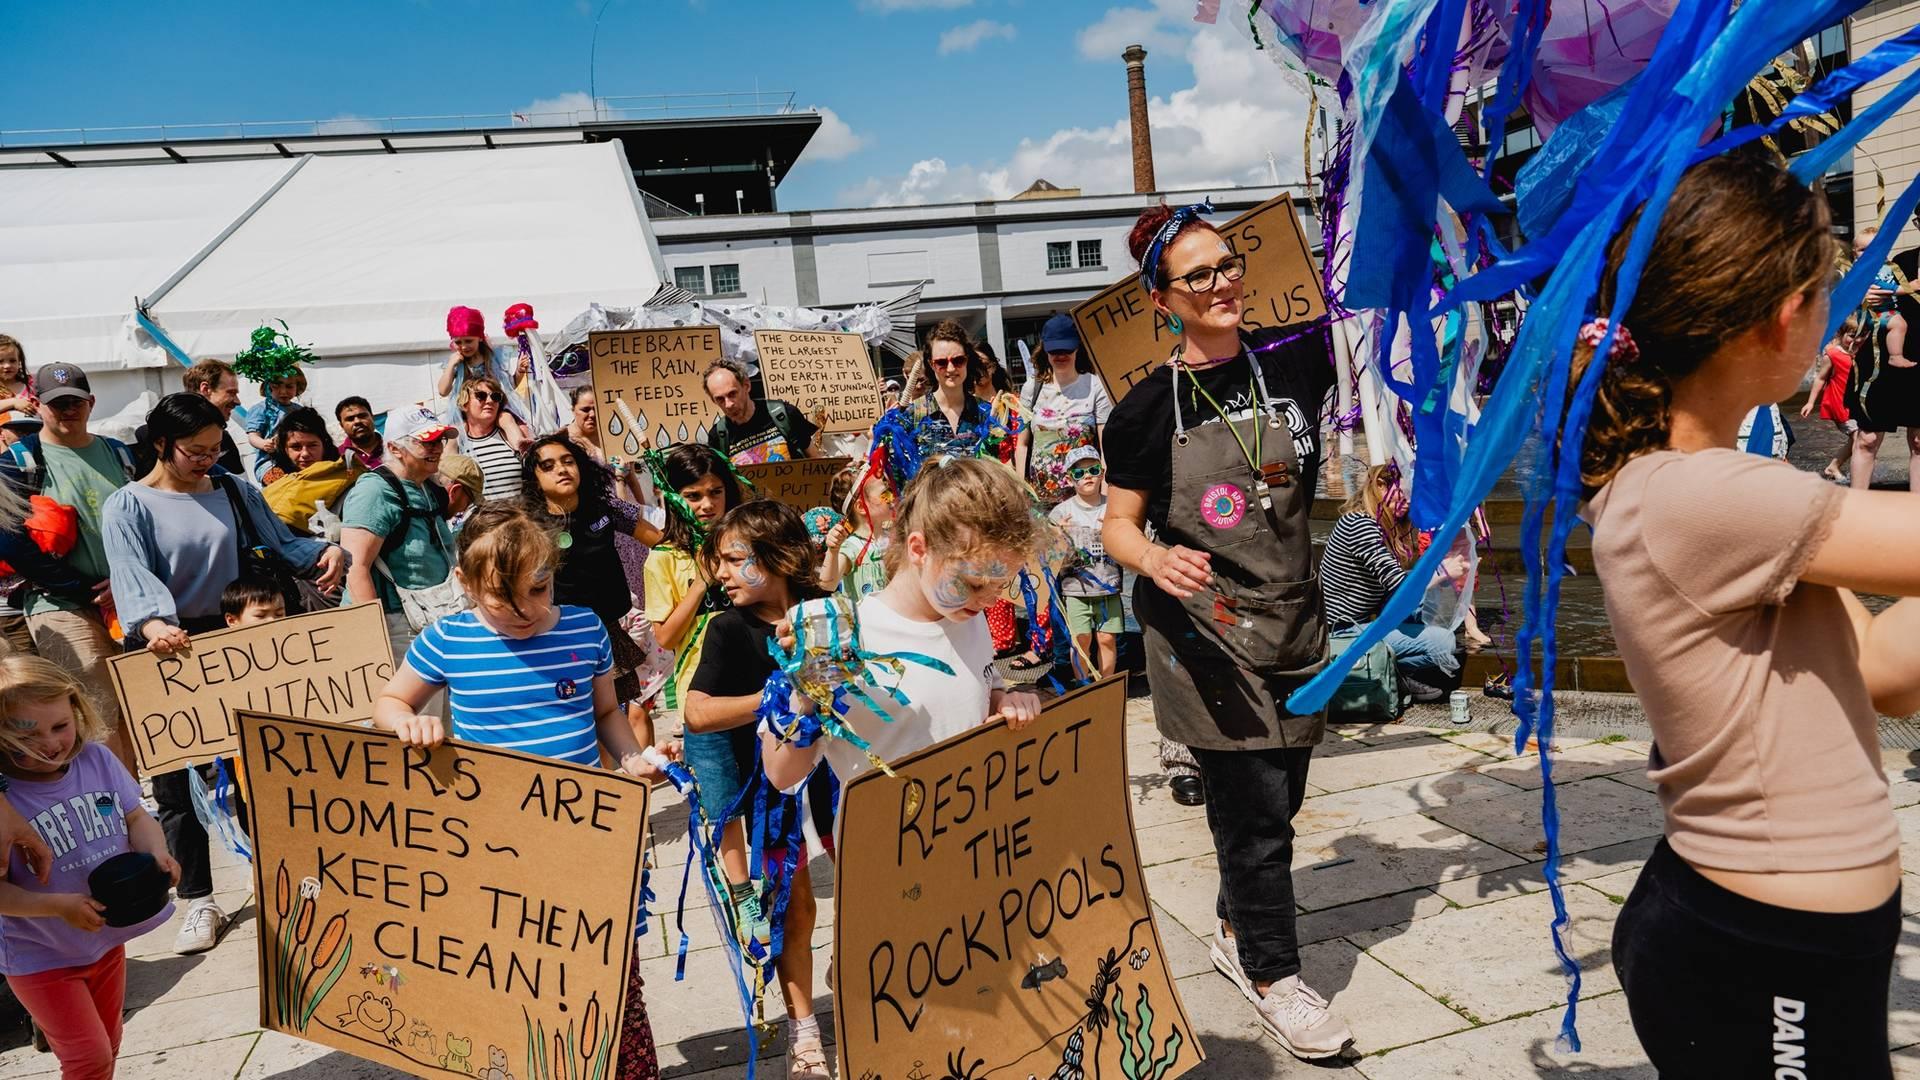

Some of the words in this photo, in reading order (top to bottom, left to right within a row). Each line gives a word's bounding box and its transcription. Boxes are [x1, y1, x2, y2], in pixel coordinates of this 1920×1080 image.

[1085, 287, 1145, 336] THE
[1271, 284, 1311, 324] US
[594, 334, 713, 357] CELEBRATE
[761, 334, 781, 343] THE
[789, 335, 825, 343] OCEAN
[833, 336, 843, 344] IS
[763, 347, 785, 356] THE
[789, 347, 838, 356] LARGEST
[610, 359, 639, 376] THE
[651, 356, 700, 379] RAIN,
[770, 359, 858, 370] ECOSYSTEM
[769, 373, 785, 382] ON
[837, 372, 847, 380] IT
[852, 372, 863, 380] IS
[603, 388, 624, 404] IT
[634, 385, 684, 401] FEEDS
[771, 385, 800, 396] HOME
[803, 384, 817, 394] TO
[820, 384, 828, 393] A
[830, 382, 876, 393] STUNNING
[805, 397, 818, 408] OF
[819, 396, 840, 407] THE
[844, 395, 877, 406] ENTIRE
[776, 465, 793, 477] DO
[802, 463, 840, 477] HAVE
[781, 483, 812, 497] PUT
[1203, 487, 1229, 509] BRISTOL
[156, 626, 335, 696] REDUCE
[259, 724, 482, 802] RIVERS
[520, 772, 623, 832] ARE
[897, 718, 1092, 867] RESPECT
[60, 844, 119, 874] CALIFORNIA
[964, 816, 1032, 880] THE
[317, 846, 450, 913] KEEP
[479, 885, 614, 966] THEM
